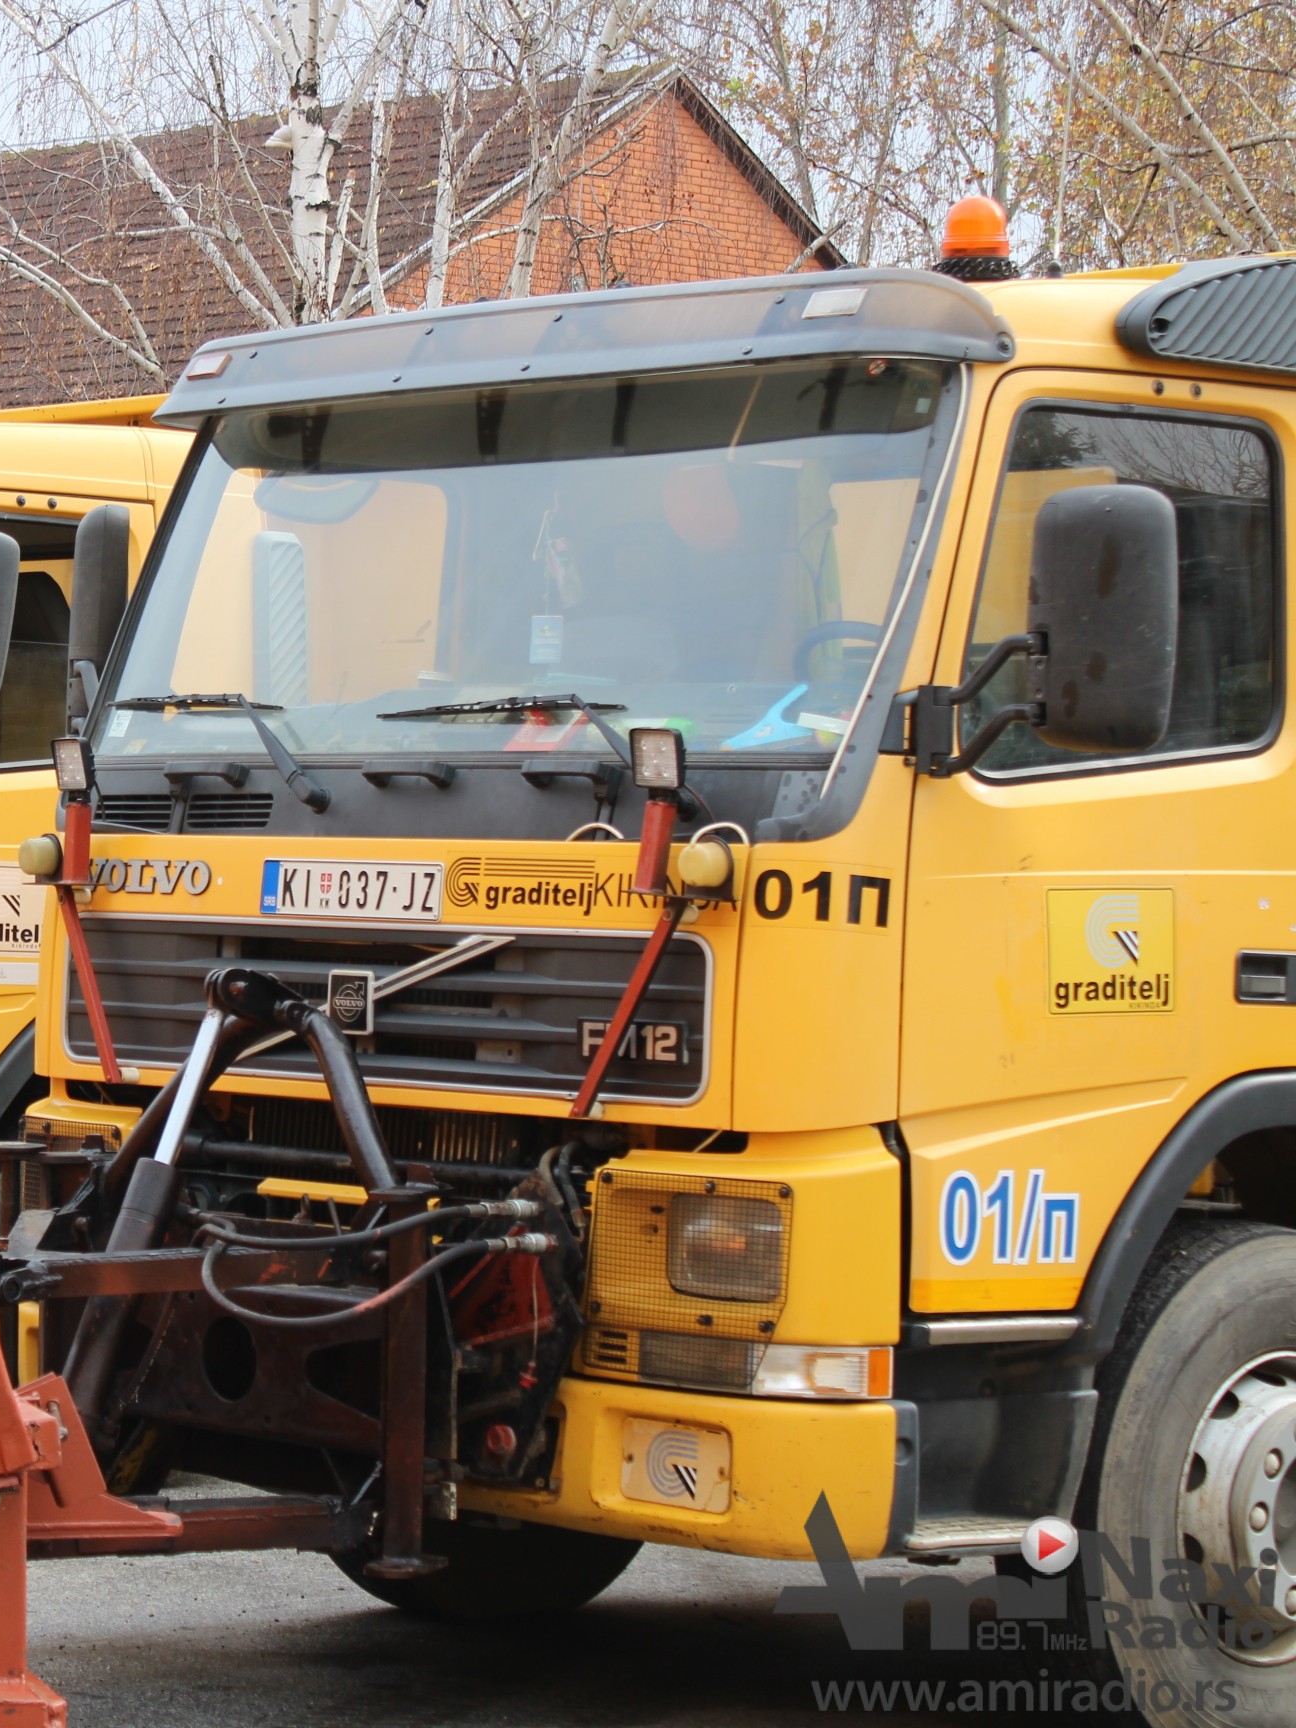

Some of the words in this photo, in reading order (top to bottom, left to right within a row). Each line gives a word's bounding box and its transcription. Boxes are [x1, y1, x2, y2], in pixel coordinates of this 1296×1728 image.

[89, 858, 212, 896] VOLVO
[282, 868, 311, 908] KI
[263, 896, 276, 907] SRB
[485, 881, 594, 917] graditelj
[335, 999, 364, 1007] VOLVO
[1054, 973, 1170, 1010] graditelj
